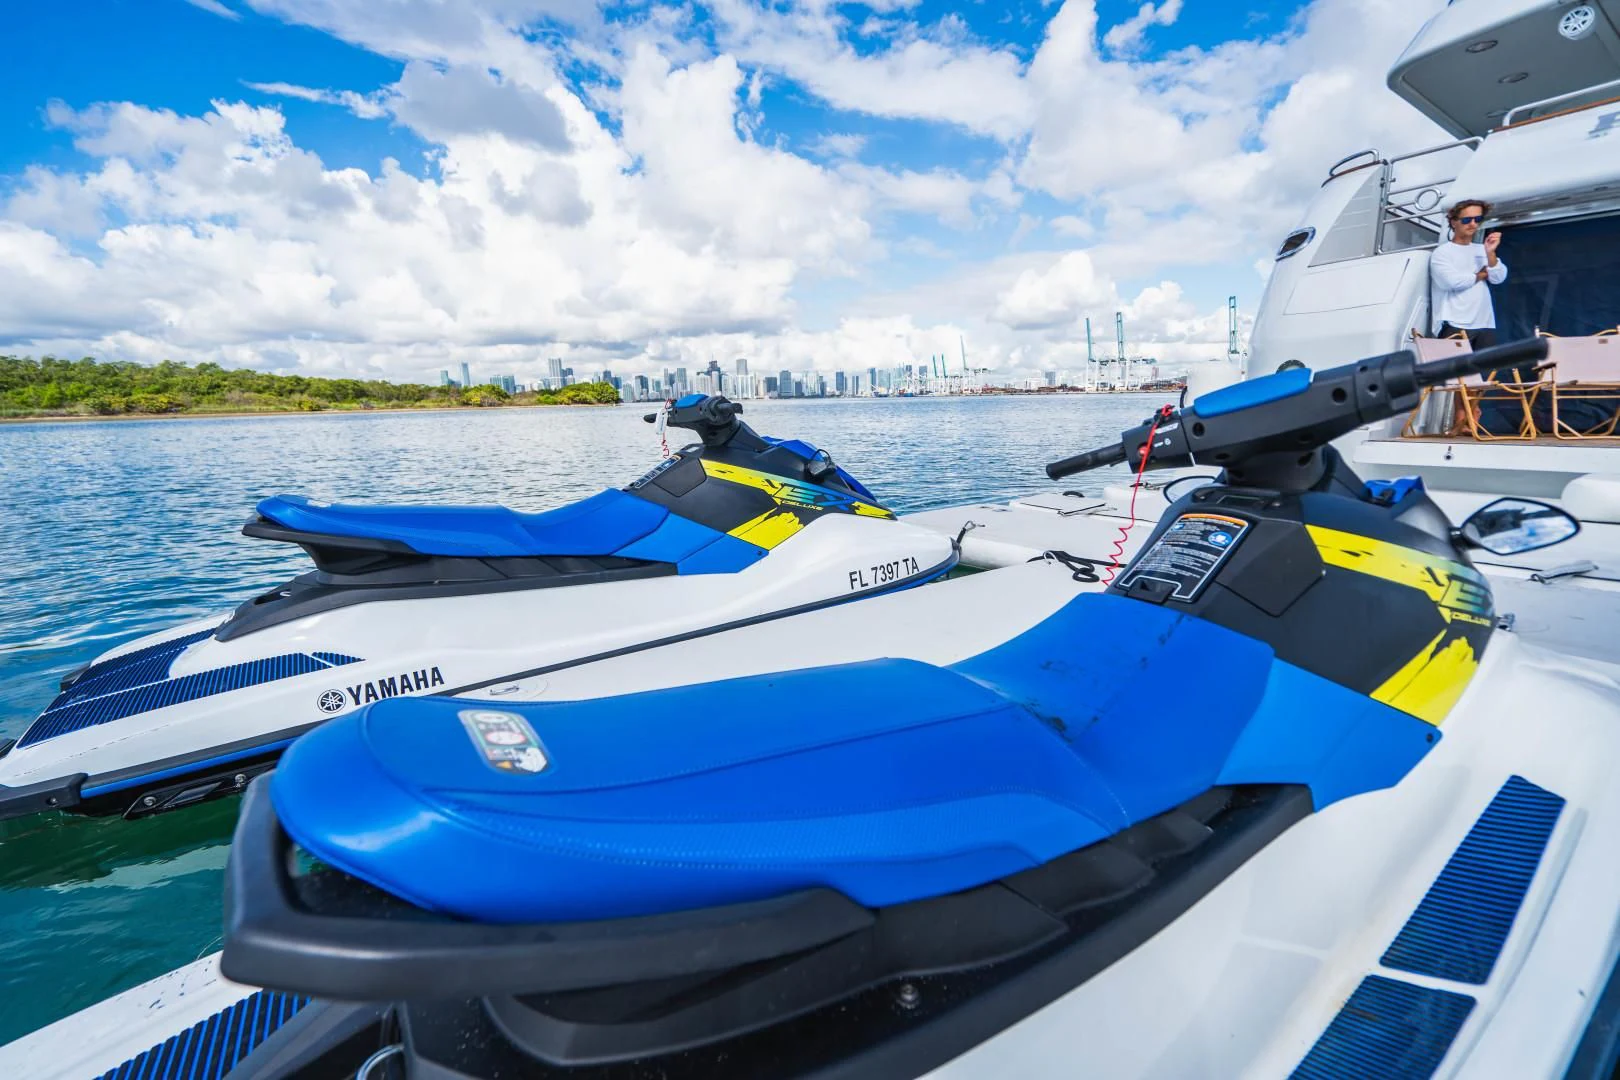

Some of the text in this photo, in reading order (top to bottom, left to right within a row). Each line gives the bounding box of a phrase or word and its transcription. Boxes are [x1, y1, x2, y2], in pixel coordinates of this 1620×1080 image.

[781, 499, 824, 511] DELUXE
[849, 556, 920, 590] FL 7397 TA
[346, 666, 445, 706] YAMAHA
